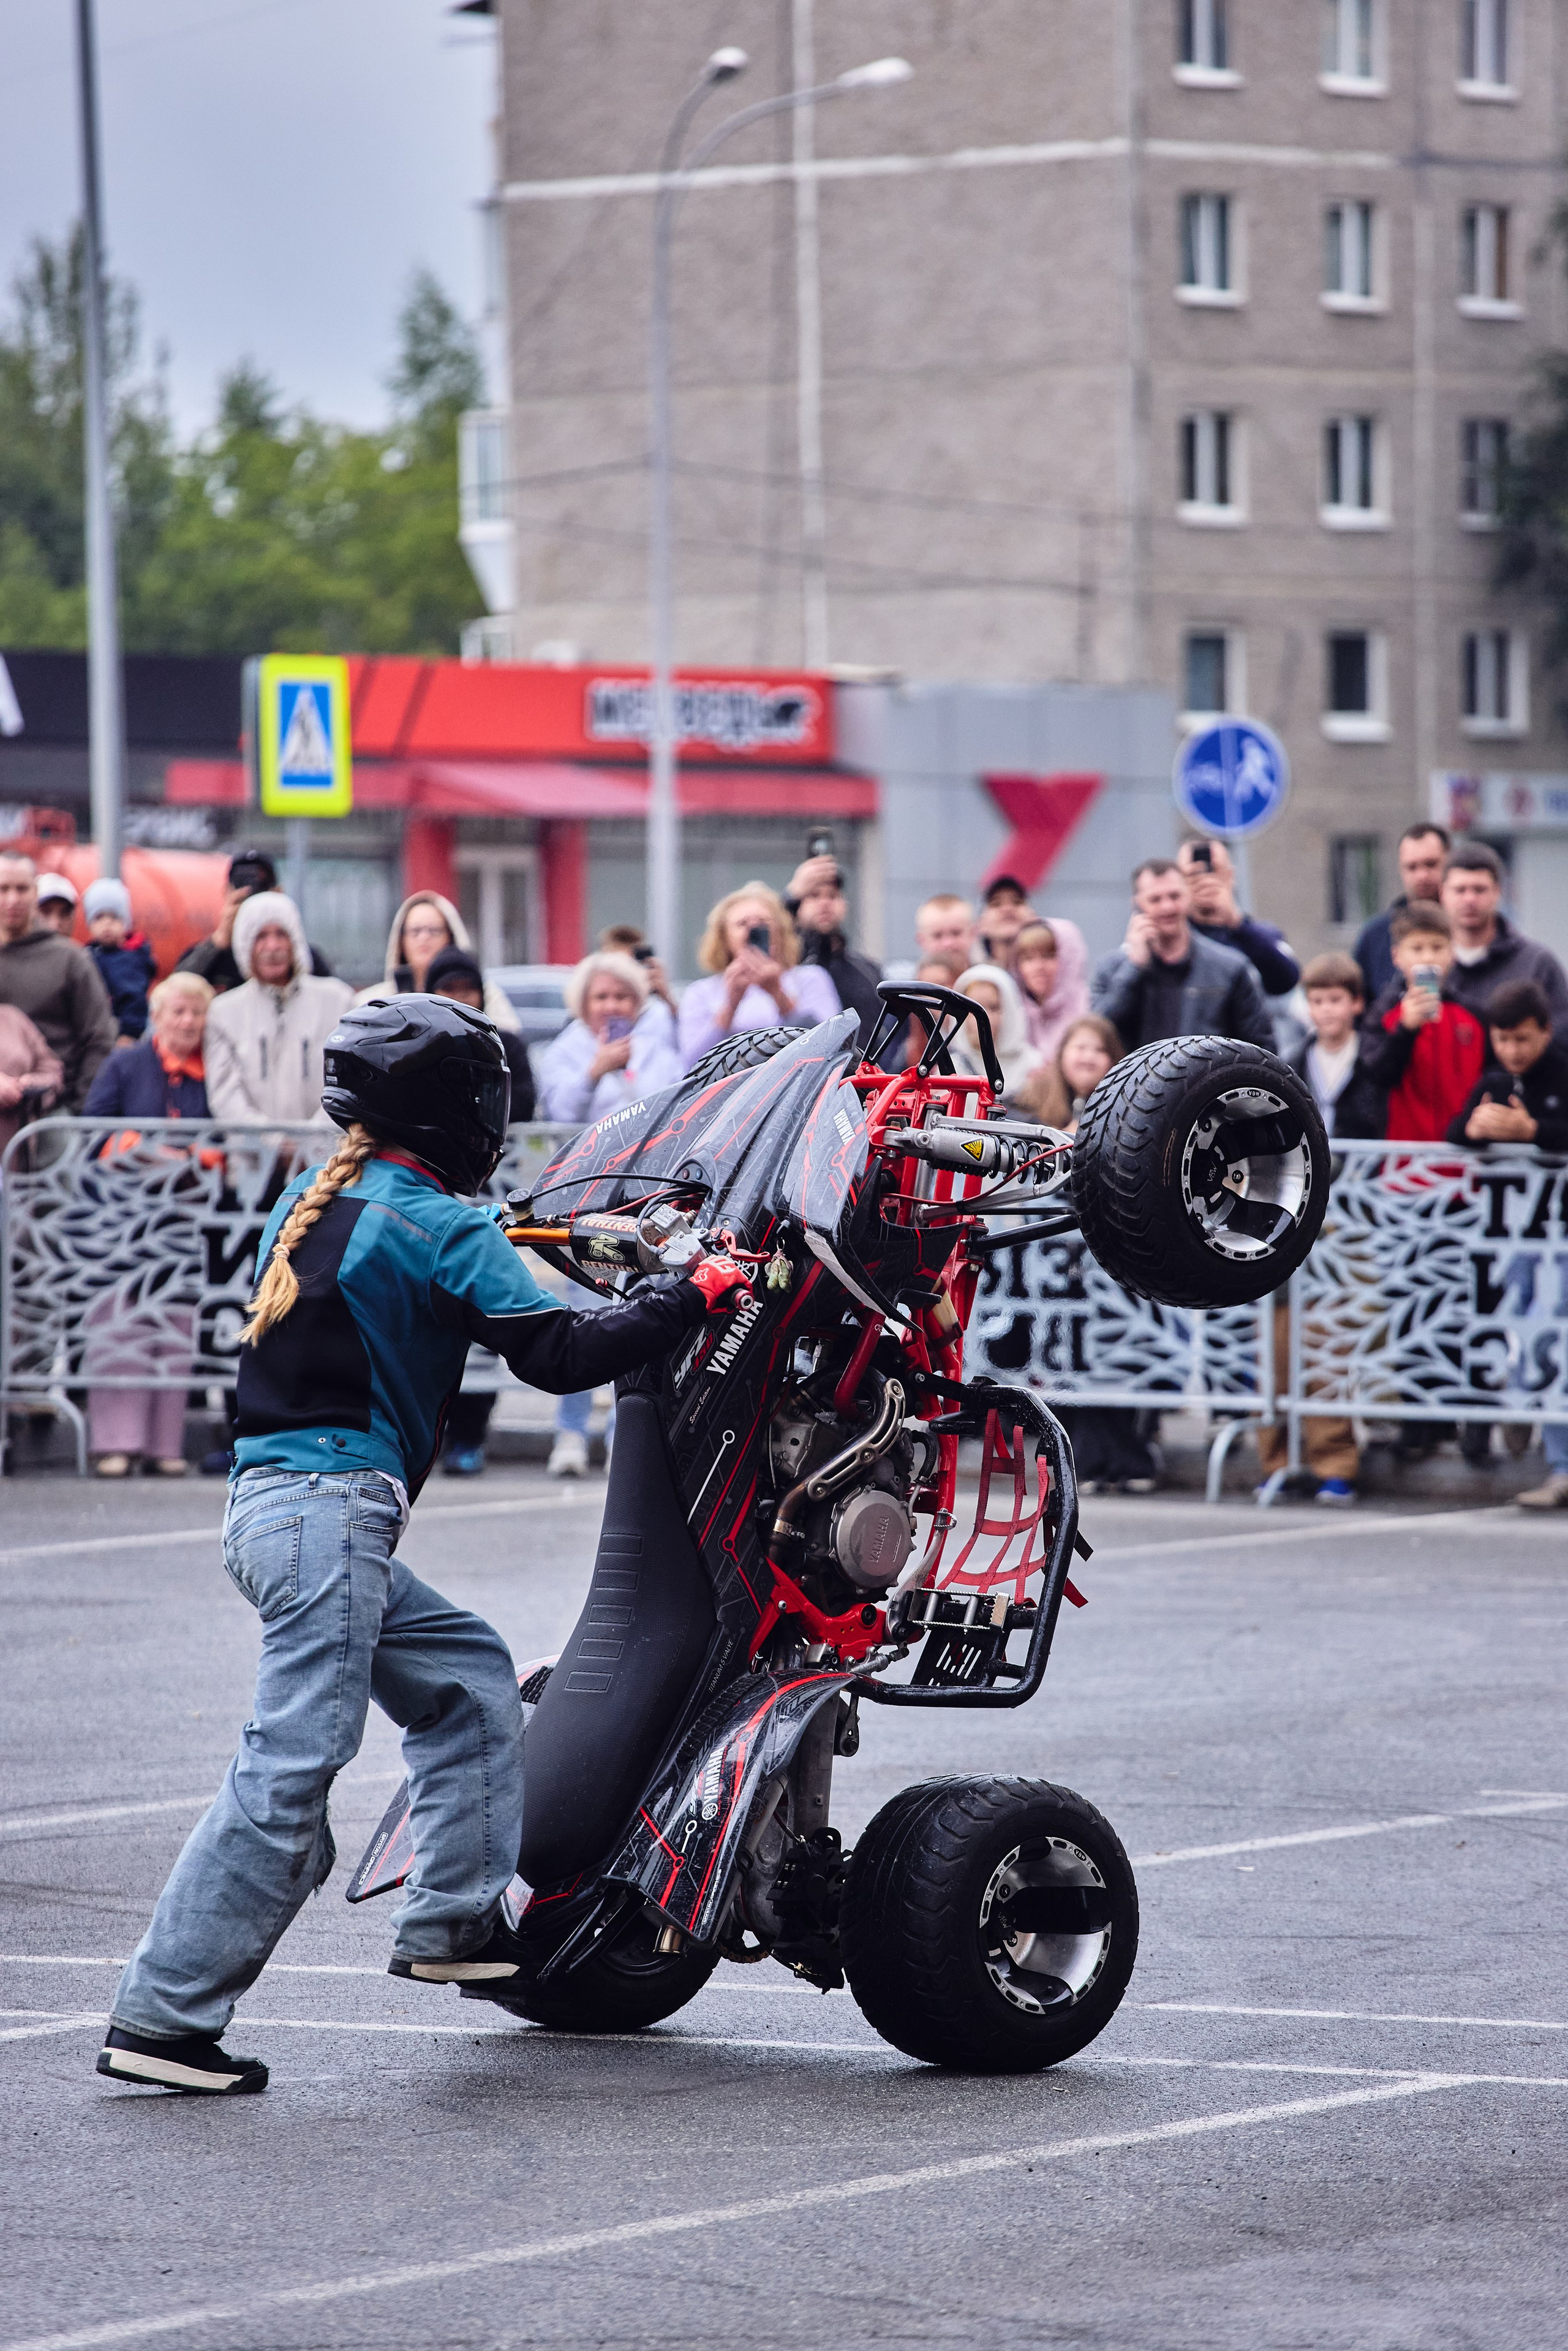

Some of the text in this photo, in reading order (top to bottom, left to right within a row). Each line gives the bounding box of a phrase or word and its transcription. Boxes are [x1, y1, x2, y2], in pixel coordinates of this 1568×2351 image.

[595, 1101, 647, 1134] YAMAHA
[833, 1108, 856, 1146] YAMAHA
[1207, 1161, 1218, 1182] VBW
[706, 1300, 764, 1375] YAMAHA
[674, 1326, 707, 1390] YFZ
[689, 1386, 711, 1424] Special Edition
[869, 1515, 889, 1563] YAMAHA
[704, 1746, 725, 1805] YAMAHA
[358, 1856, 375, 1885] GRAPHICS
[1075, 1849, 1086, 1860] VBW
[998, 1911, 1011, 1929] VBW
